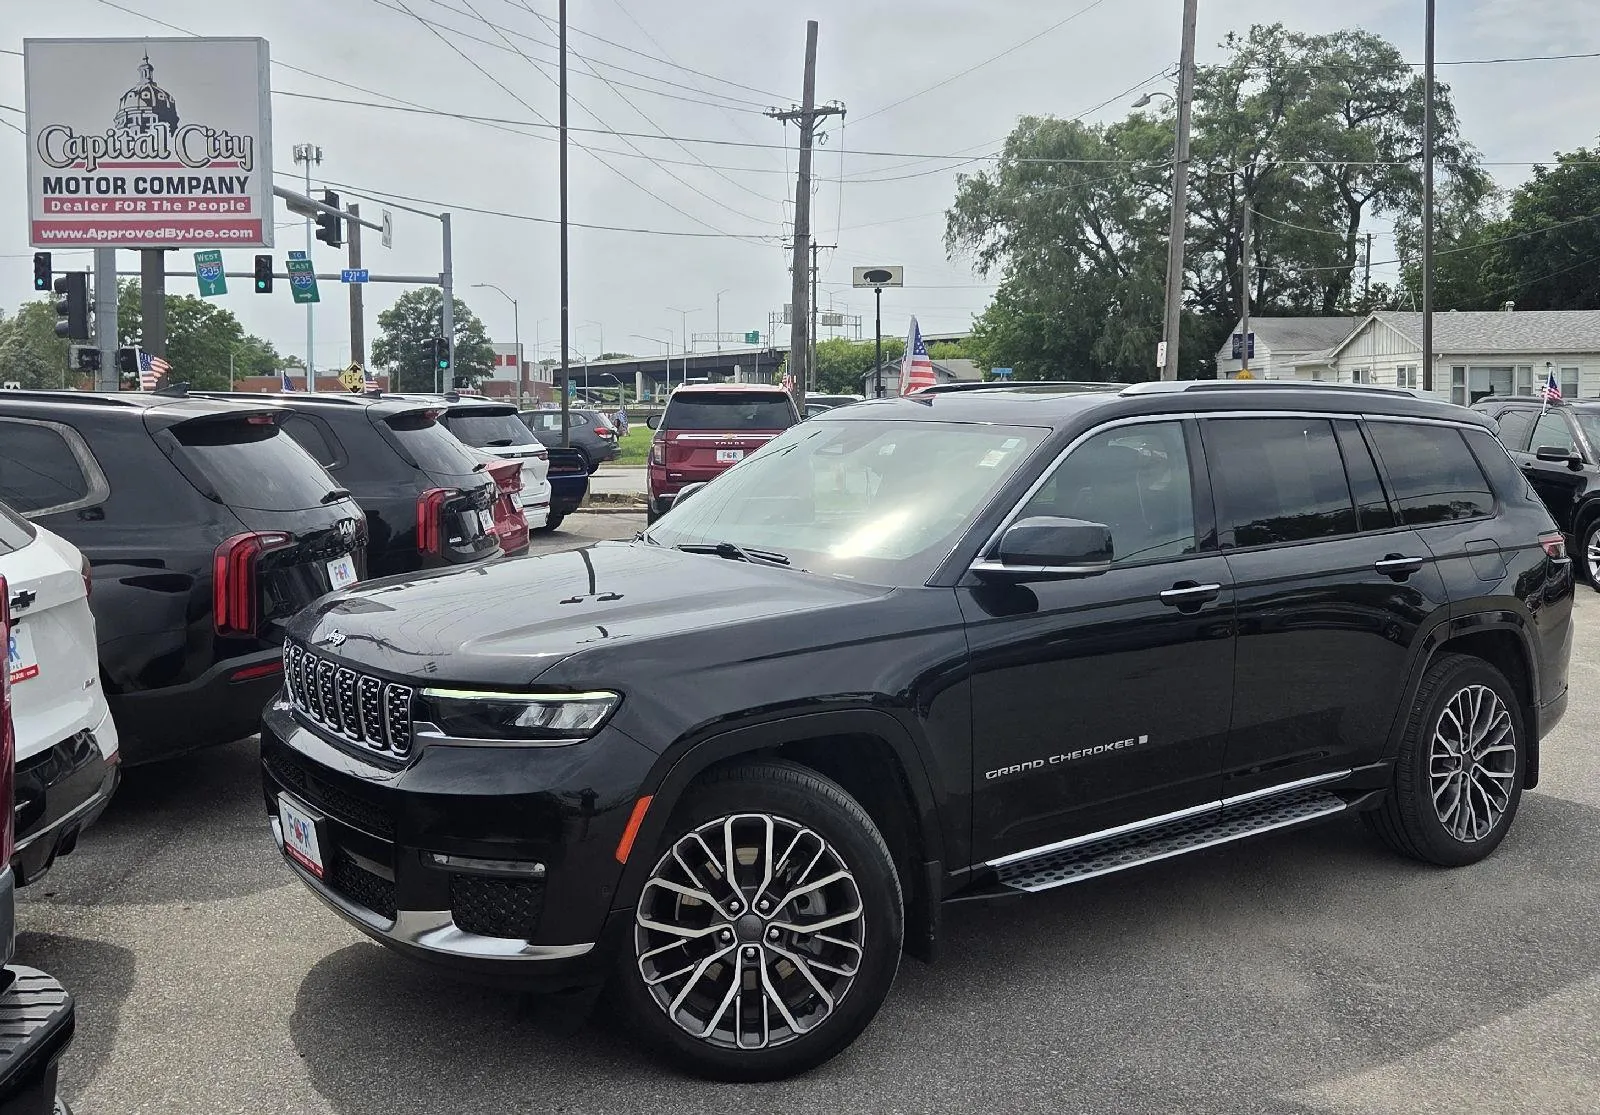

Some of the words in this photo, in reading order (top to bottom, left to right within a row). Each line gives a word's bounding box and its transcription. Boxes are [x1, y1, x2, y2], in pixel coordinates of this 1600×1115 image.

[37, 124, 170, 172] Capital
[175, 124, 253, 171] City
[43, 176, 126, 194] MOTOR
[134, 176, 249, 194] COMPANY
[51, 200, 109, 211] Dealer
[115, 200, 146, 211] FOR
[152, 200, 182, 211] The
[188, 200, 246, 213] People
[41, 227, 253, 240] www.ApprovedByJoe.com
[197, 253, 218, 262] WEST
[201, 266, 220, 277] 235
[289, 262, 309, 270] EAST
[293, 275, 312, 285] 235
[325, 628, 347, 647] Jeep
[985, 759, 1045, 780] GRAND
[1049, 738, 1135, 764] CHEROKEE
